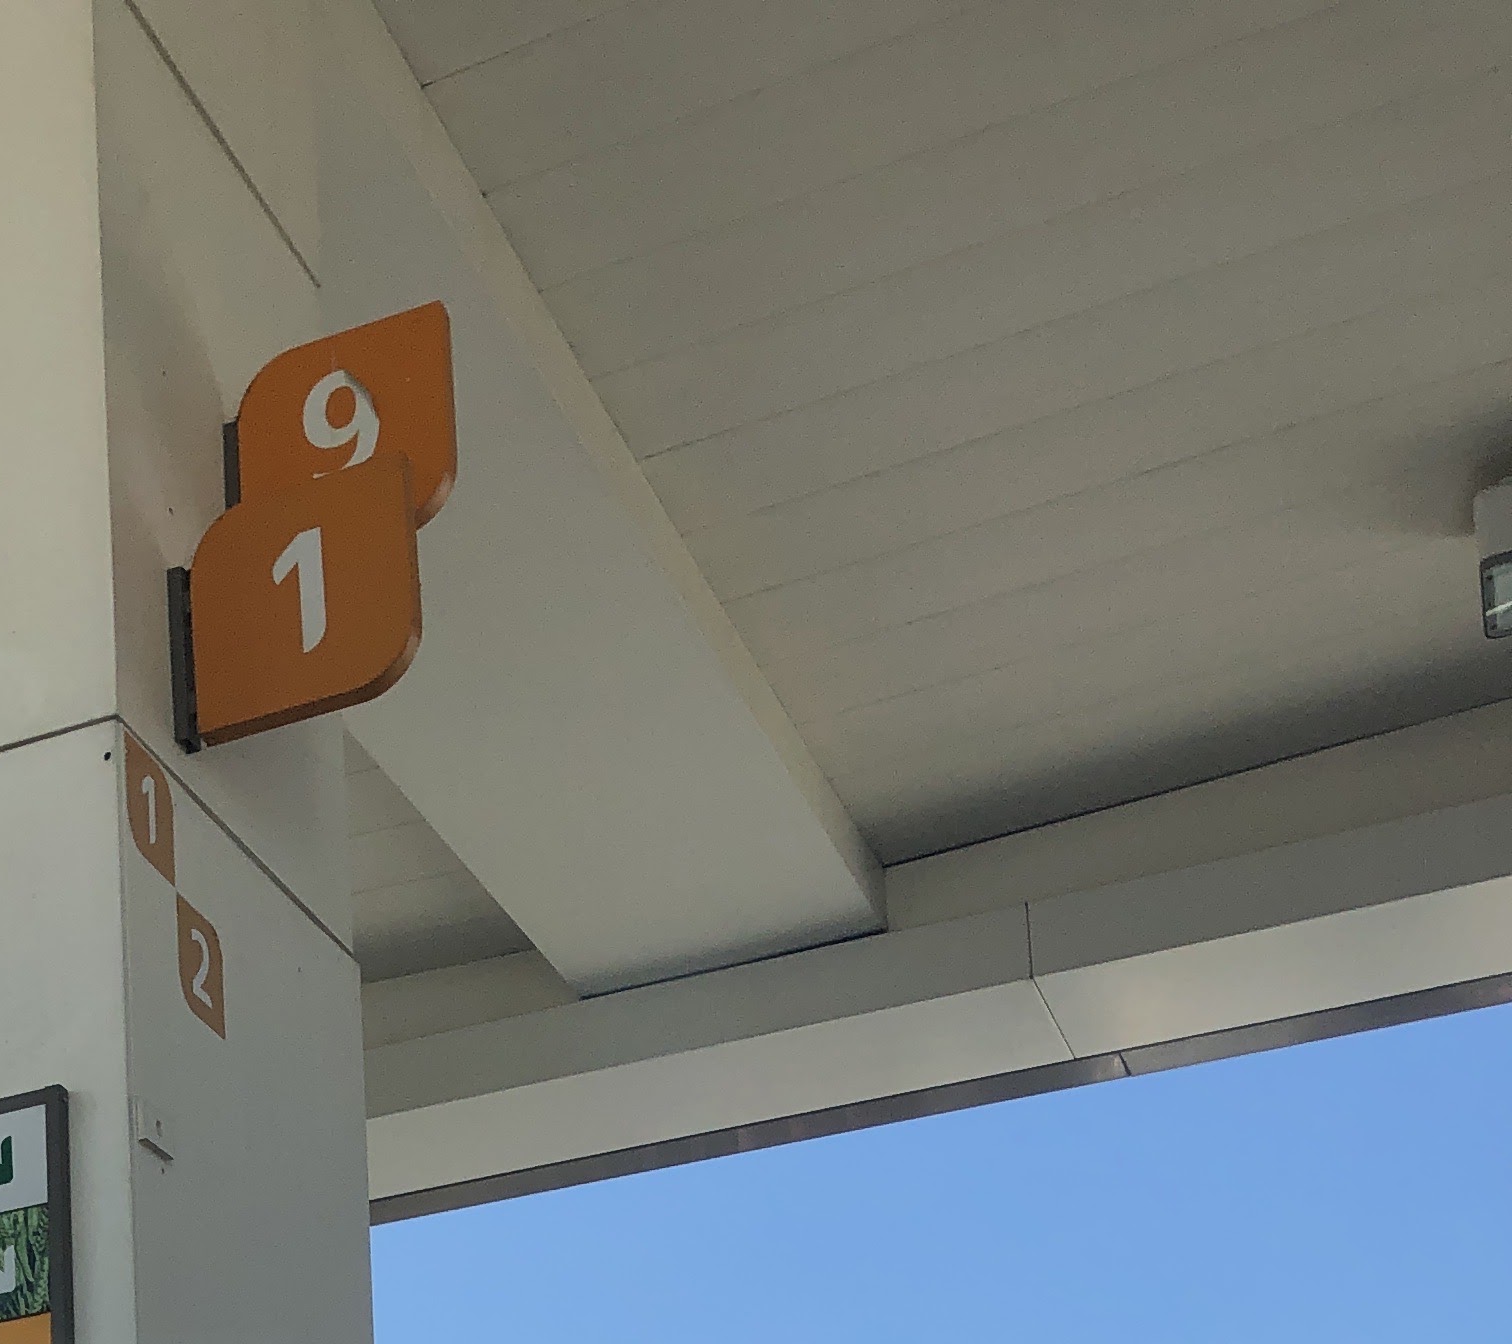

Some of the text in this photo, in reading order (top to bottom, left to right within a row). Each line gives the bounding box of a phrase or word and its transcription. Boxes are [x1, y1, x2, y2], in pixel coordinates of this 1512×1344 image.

[301, 367, 380, 479] 9
[271, 526, 327, 654] 1
[140, 774, 160, 846] 1
[189, 926, 213, 1010] 2
